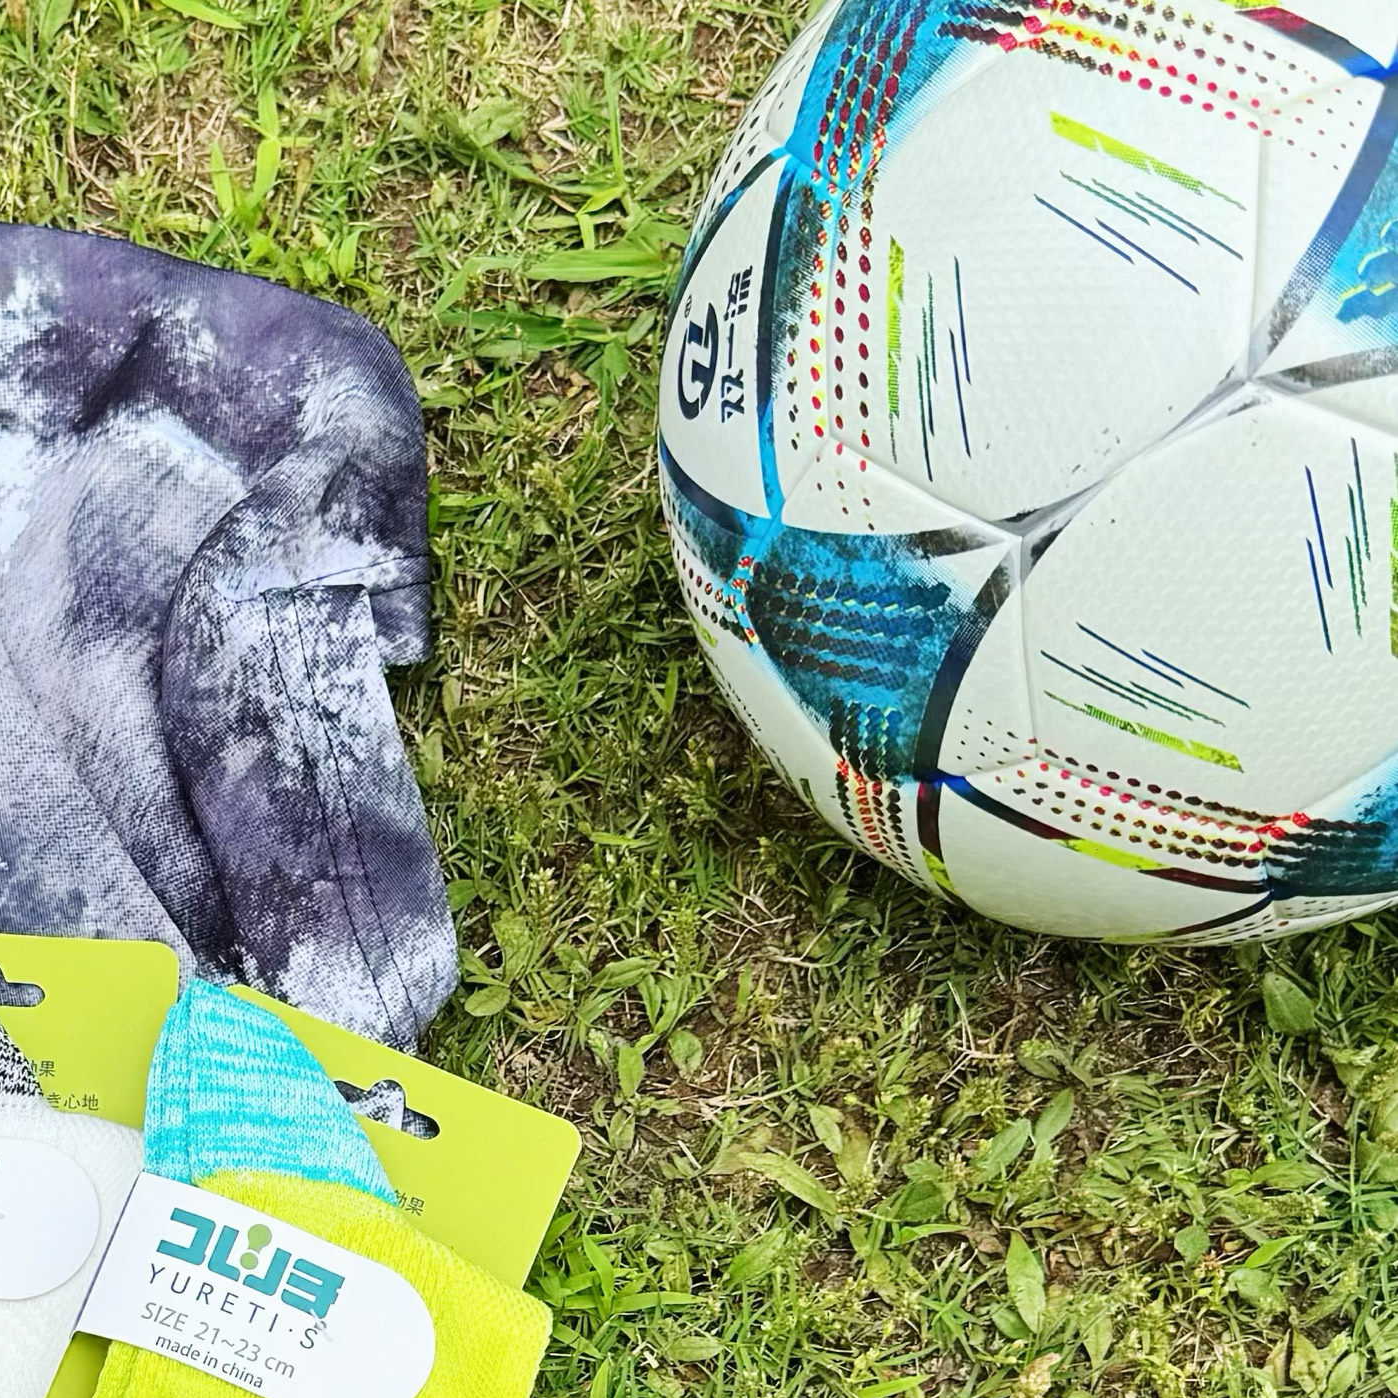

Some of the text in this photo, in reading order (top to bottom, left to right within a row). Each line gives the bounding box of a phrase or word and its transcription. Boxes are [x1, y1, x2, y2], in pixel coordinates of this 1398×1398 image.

[141, 1301, 295, 1379] SIZE 21~23 cm
[155, 1335, 264, 1389] made in china
